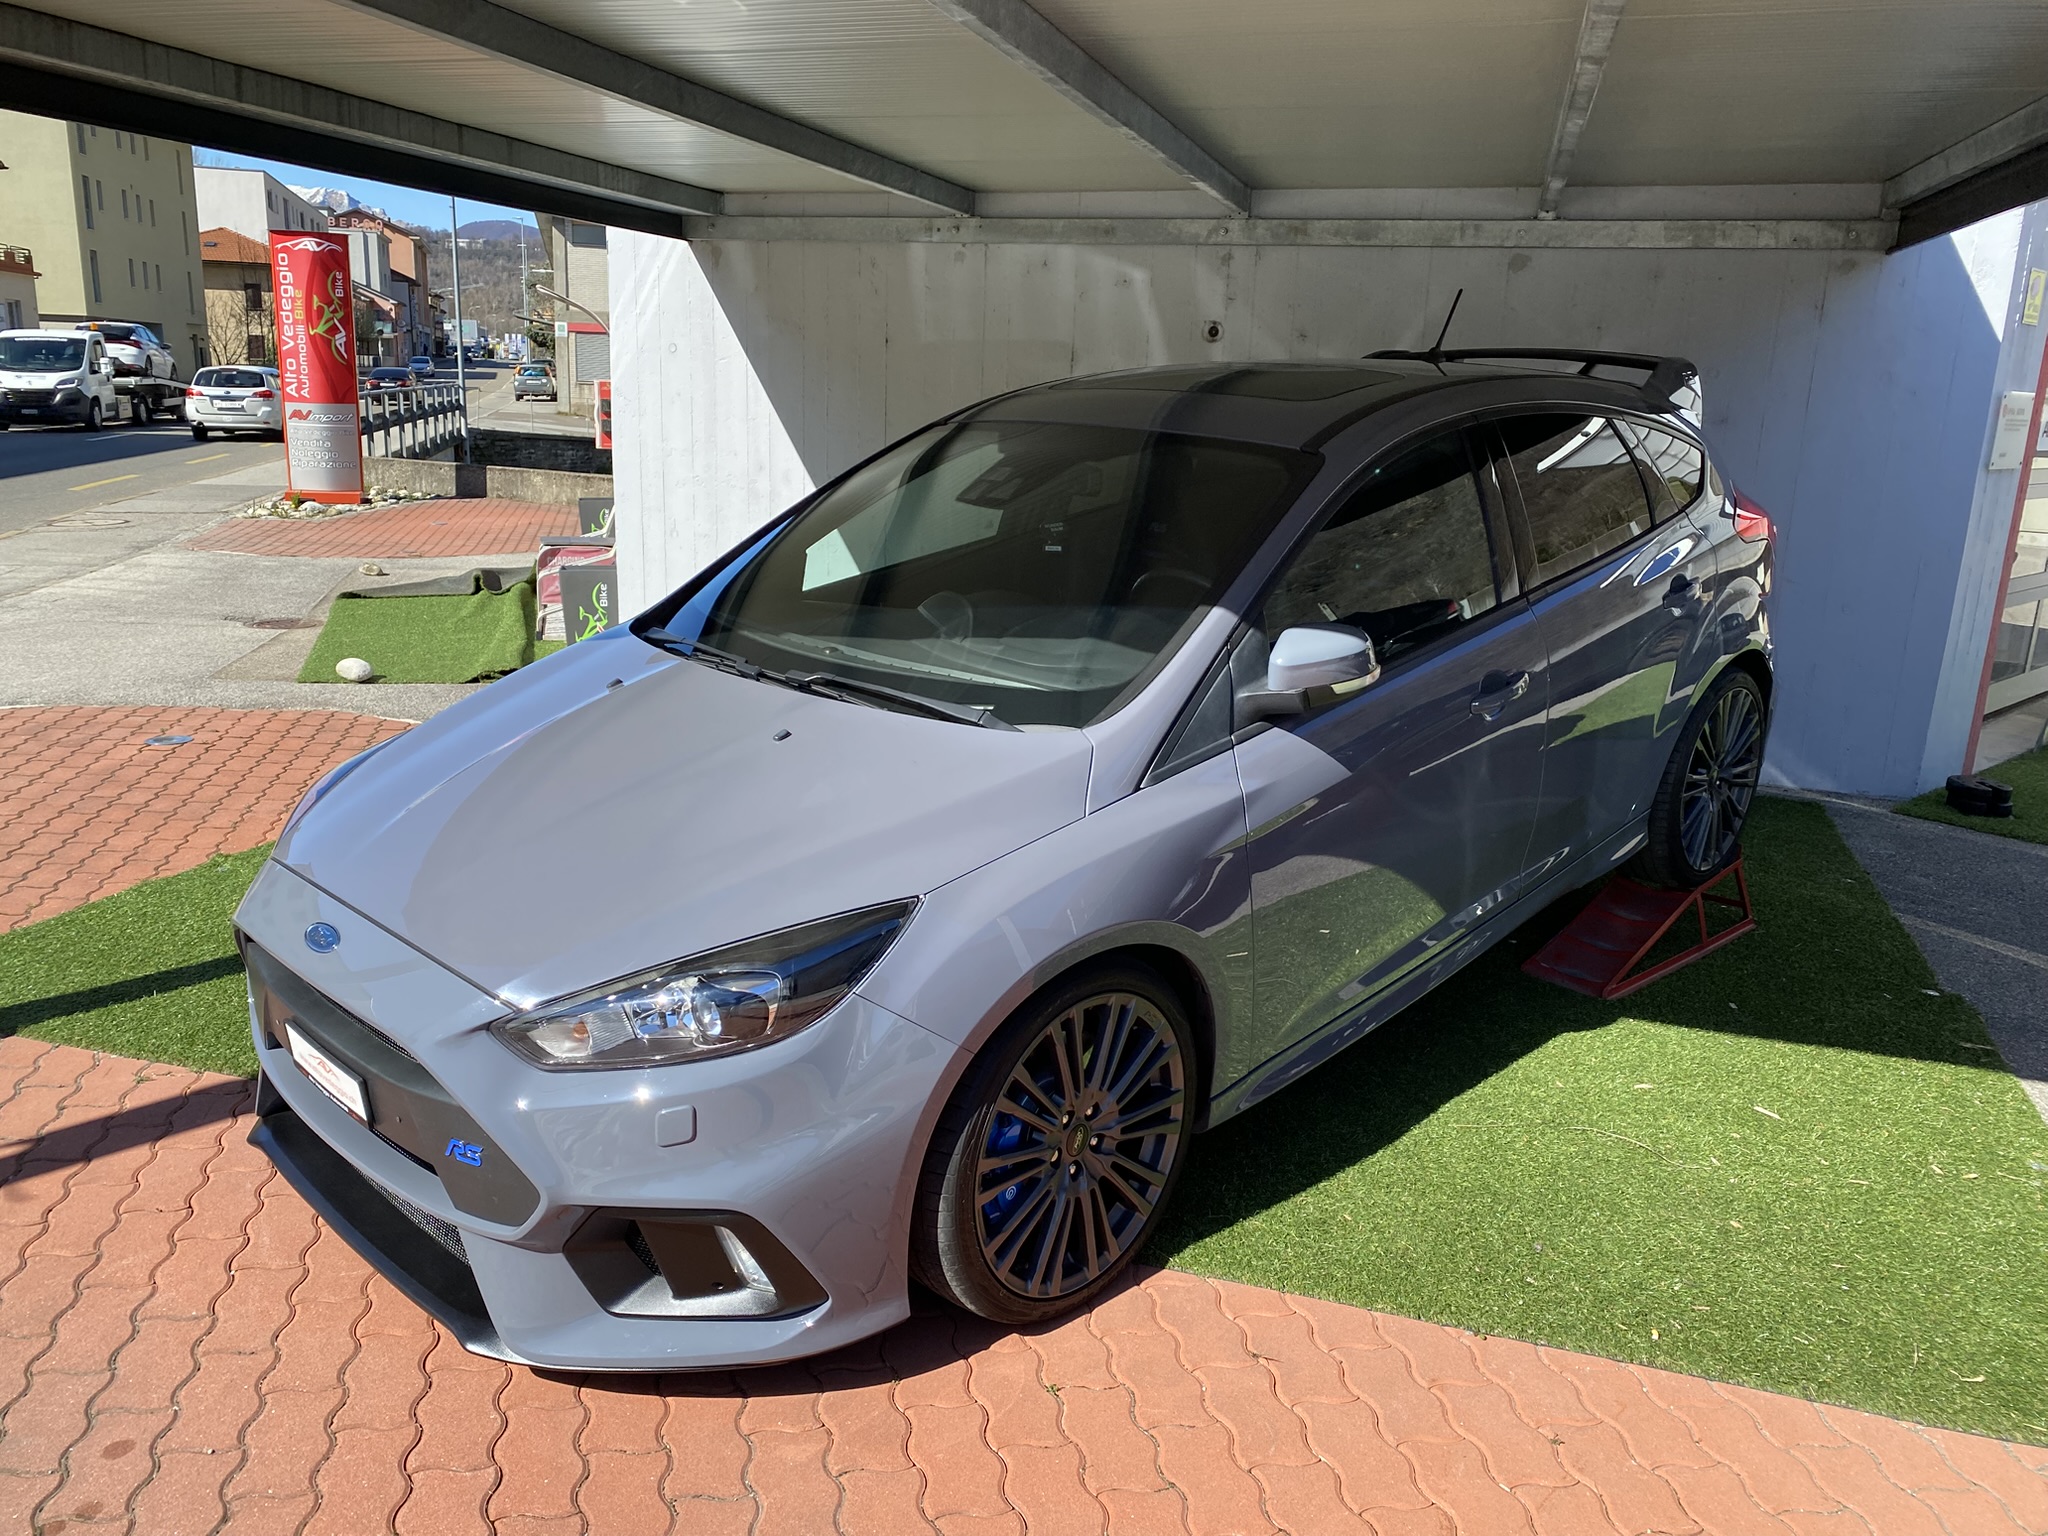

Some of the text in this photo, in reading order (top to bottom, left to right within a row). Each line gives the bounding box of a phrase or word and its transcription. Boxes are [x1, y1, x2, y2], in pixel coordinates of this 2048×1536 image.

[335, 271, 344, 297] Bike
[276, 253, 298, 398] Alto Vedeggio
[290, 438, 331, 448] Vendita
[291, 448, 339, 459] Noleggio
[292, 459, 357, 468] Riparazione
[599, 583, 608, 607] Bike
[445, 1138, 483, 1167] RS
